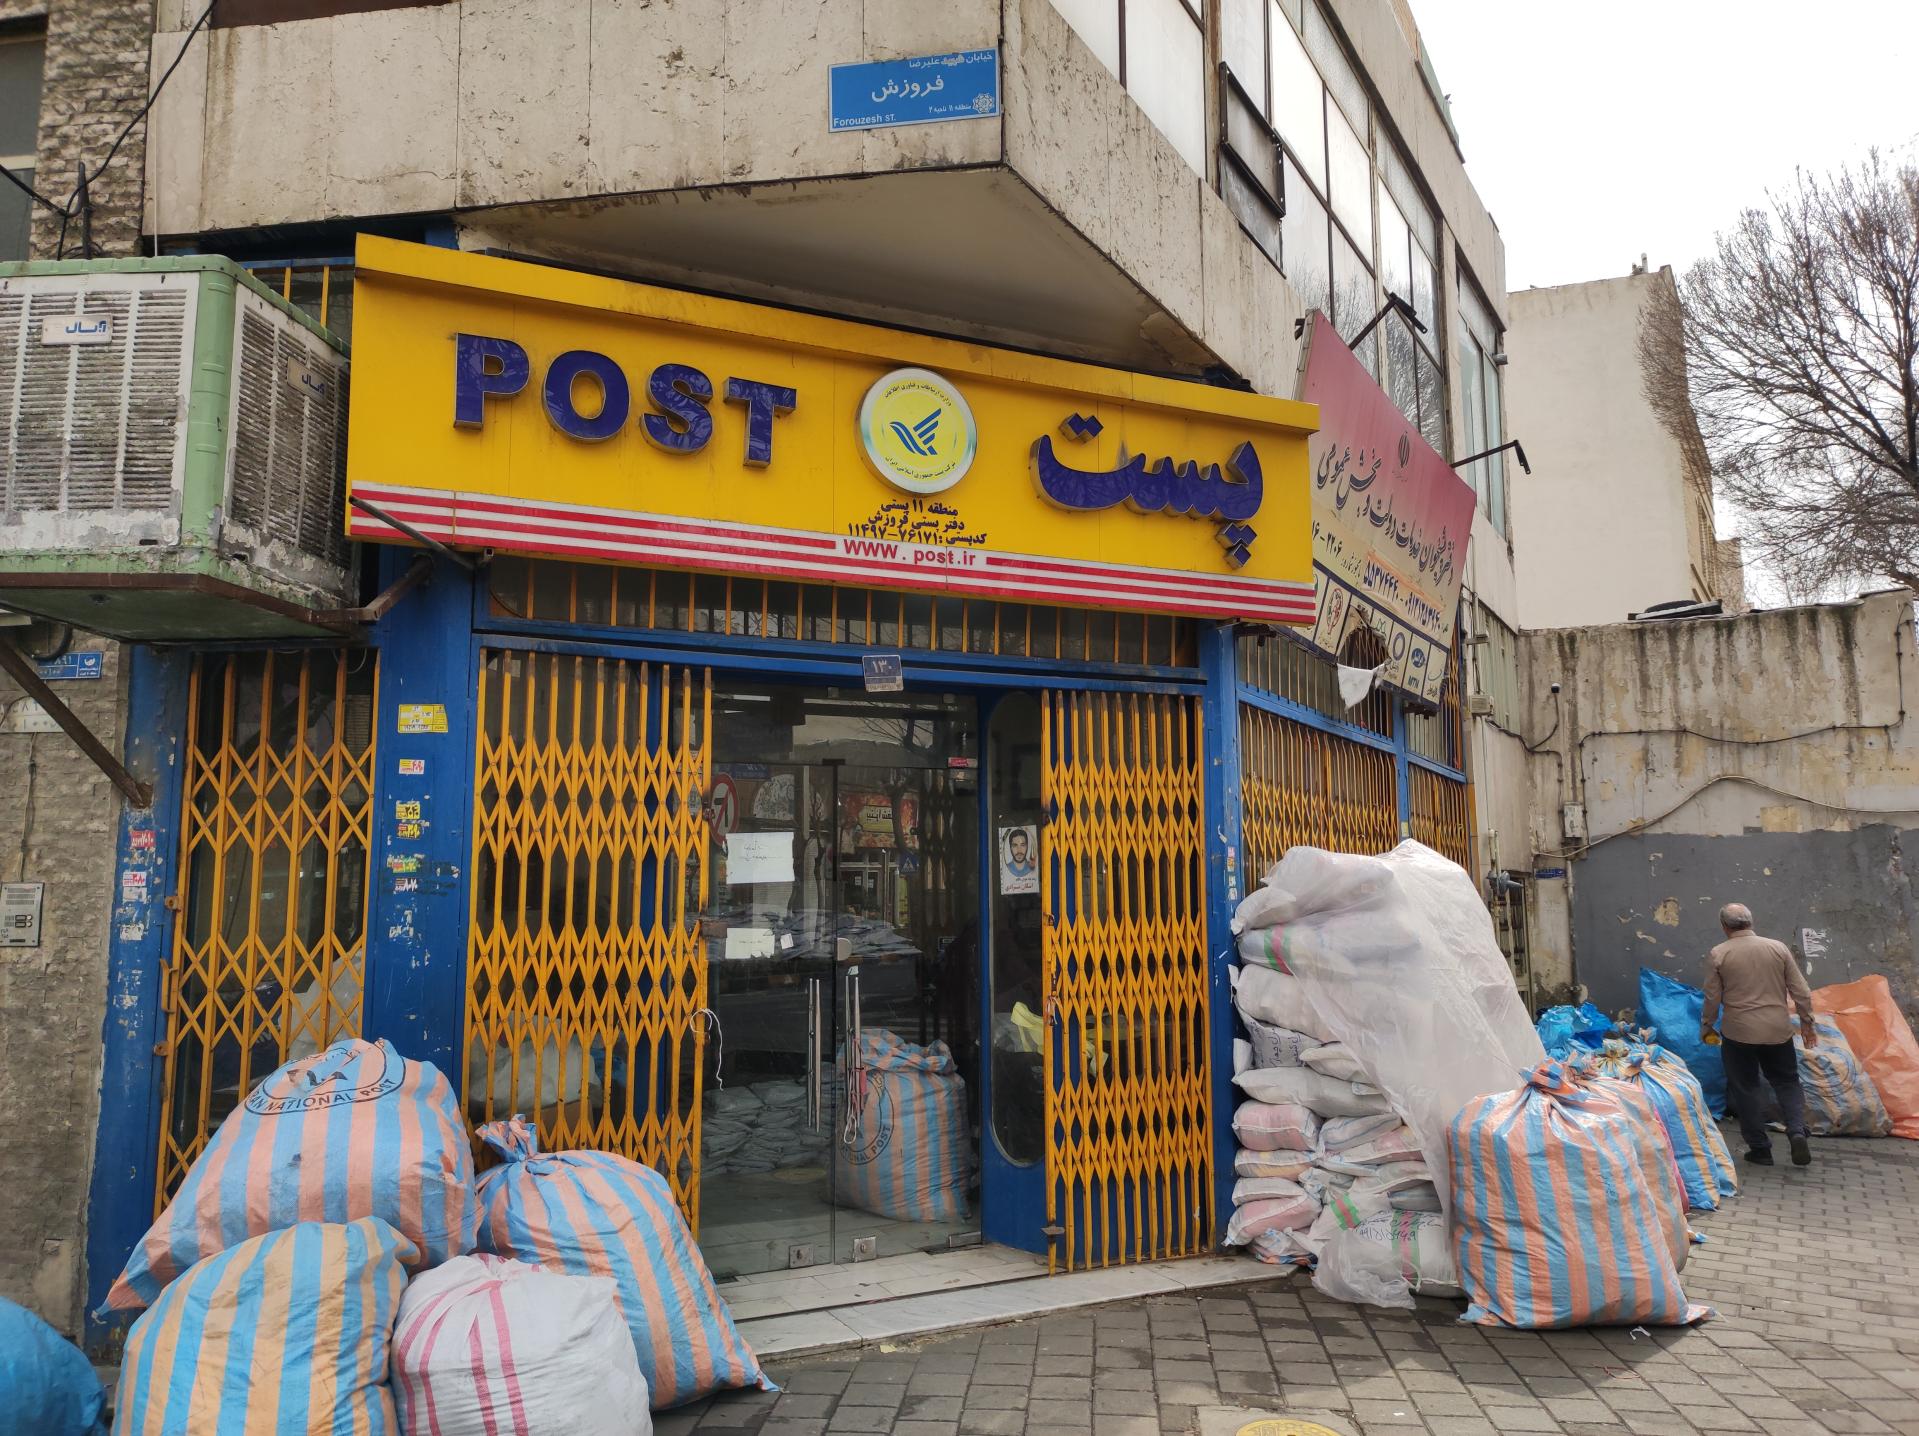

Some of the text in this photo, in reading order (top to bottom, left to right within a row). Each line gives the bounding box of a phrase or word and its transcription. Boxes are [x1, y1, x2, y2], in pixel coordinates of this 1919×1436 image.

[909, 58, 940, 69] علیرضا
[966, 51, 993, 64] خیابان
[872, 75, 944, 102] فروزش
[833, 114, 882, 127] Forouzesh
[452, 332, 797, 468] POST
[1317, 443, 1350, 490] عمومی
[1029, 412, 1263, 570] پست
[868, 511, 965, 533] دفتر پستی فروزش
[881, 499, 959, 519] منطقه ۱۱ پستی
[264, 1092, 352, 1112] NATIONAL
[360, 1078, 397, 1097] POST
[871, 1126, 890, 1154] POST
